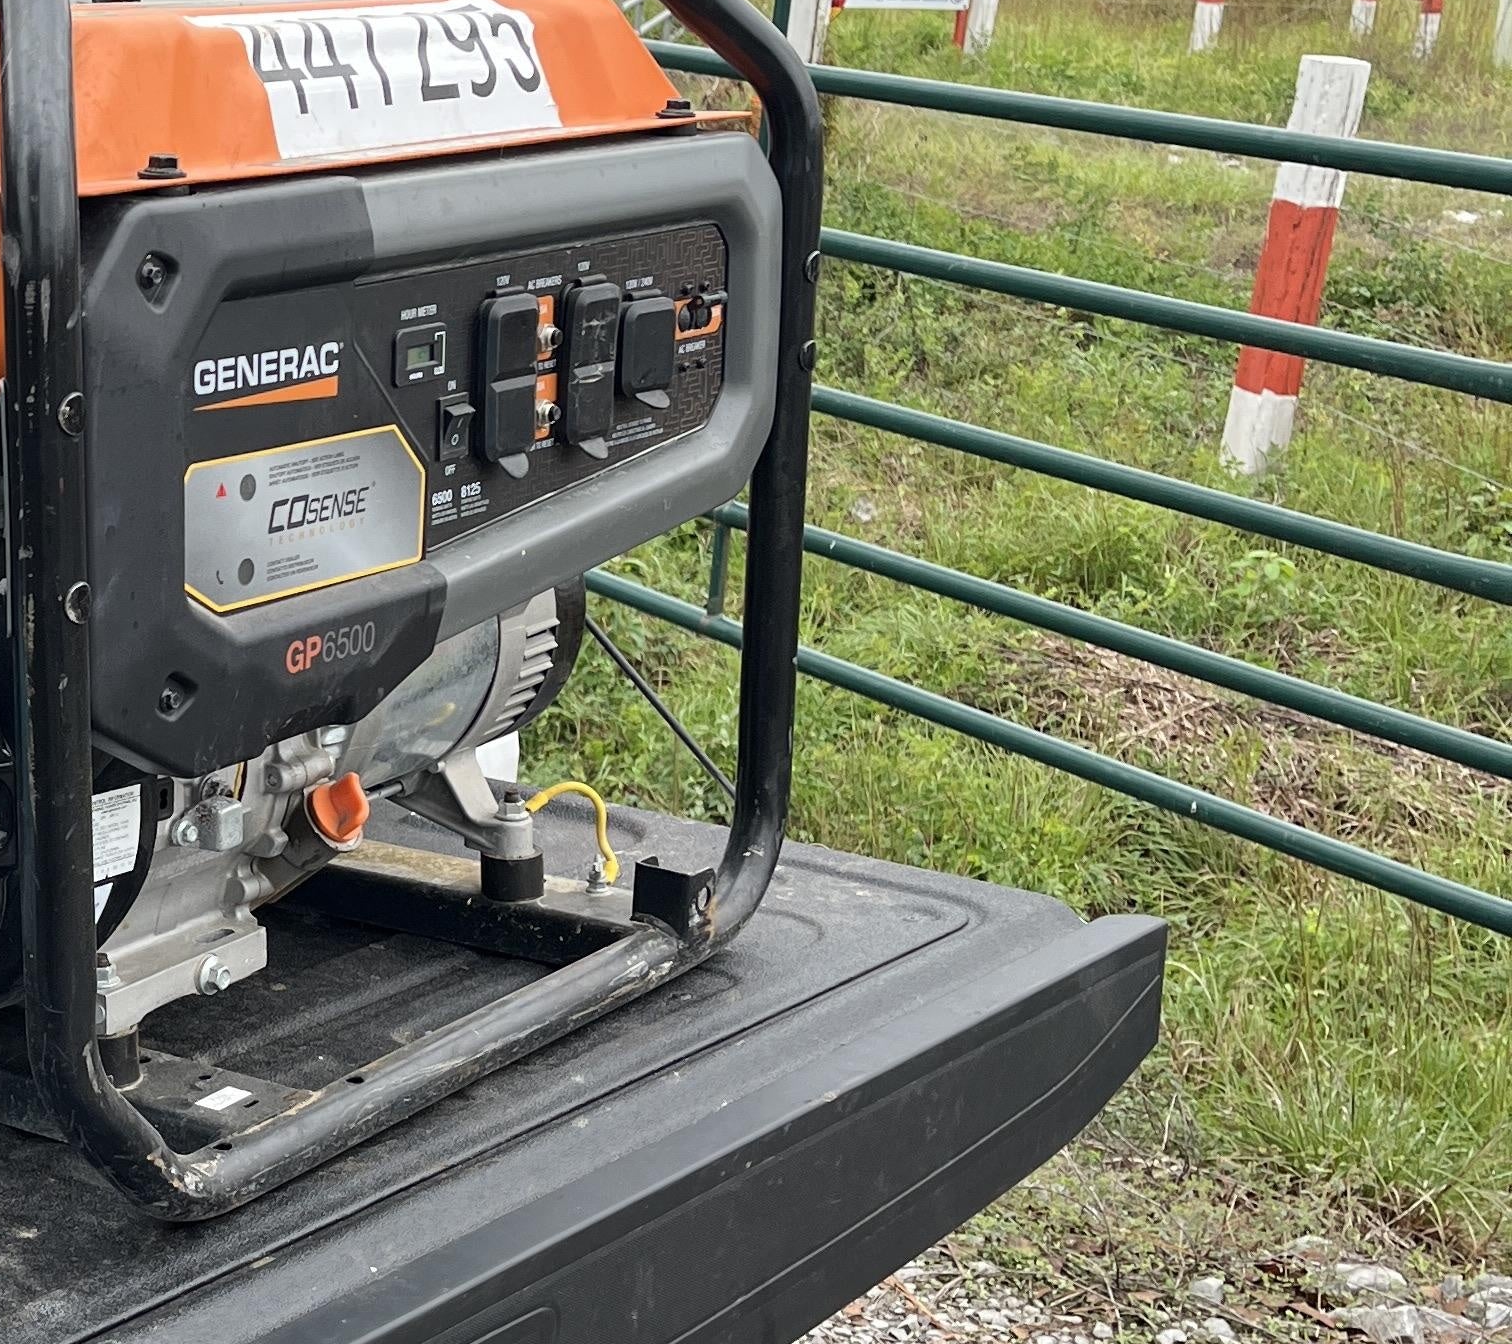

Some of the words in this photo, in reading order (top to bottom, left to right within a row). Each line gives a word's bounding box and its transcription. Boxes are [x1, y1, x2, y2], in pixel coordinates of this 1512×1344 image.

[527, 280, 536, 290] AC
[535, 274, 563, 290] BREAKERS
[400, 308, 417, 321] HOUR
[417, 304, 437, 318] METER
[193, 341, 340, 395] GENERAC
[432, 488, 453, 506] 6500
[460, 481, 481, 498] 8125
[268, 486, 369, 534] COSENSE
[269, 517, 365, 546] TECHNOLOGY
[285, 621, 375, 674] GP6500
